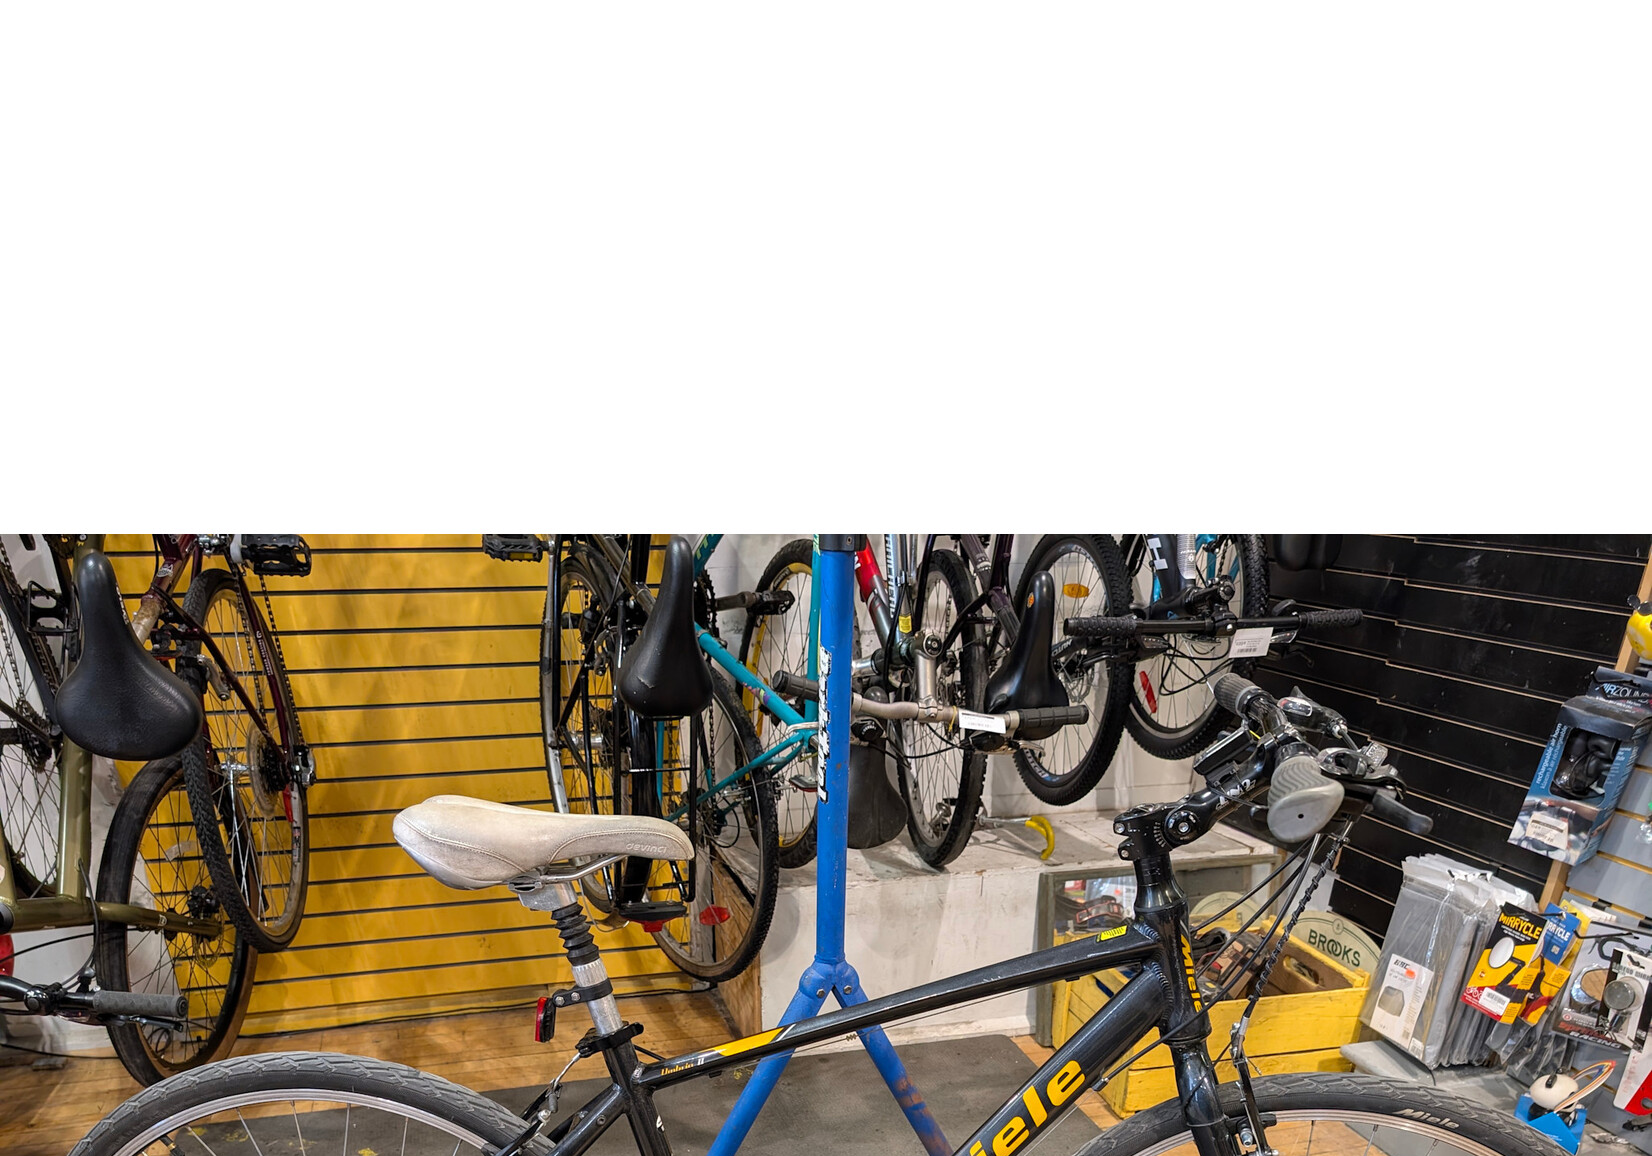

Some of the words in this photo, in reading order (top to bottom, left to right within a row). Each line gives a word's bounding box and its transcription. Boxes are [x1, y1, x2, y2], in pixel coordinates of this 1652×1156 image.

[1536, 746, 1554, 785] rechargeable
[1550, 723, 1563, 739] horn
[625, 842, 668, 855] devinci
[1498, 912, 1543, 940] MIRRYCLE
[1546, 920, 1572, 942] RRYCLE
[1307, 928, 1361, 968] BROOKS
[1180, 933, 1203, 1014] Miele
[660, 1062, 695, 1077] Umbria
[1392, 1108, 1460, 1130] Miele
